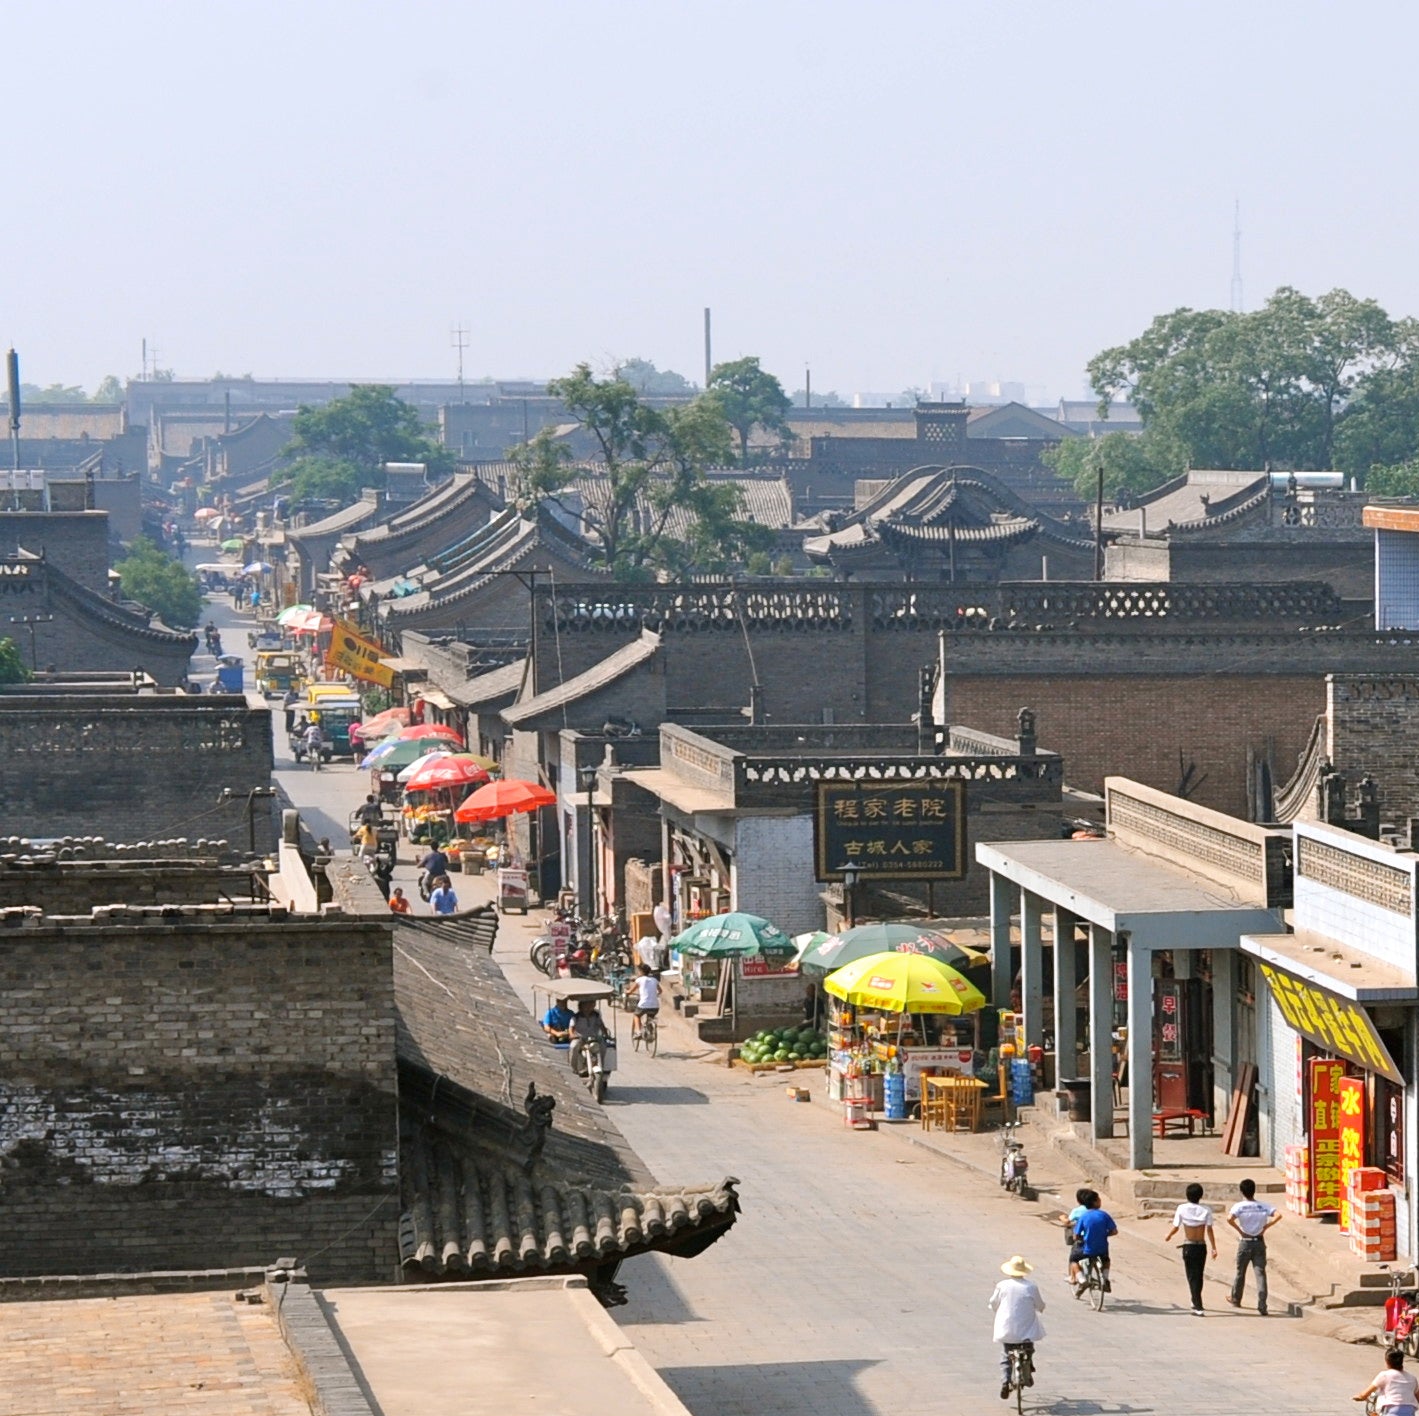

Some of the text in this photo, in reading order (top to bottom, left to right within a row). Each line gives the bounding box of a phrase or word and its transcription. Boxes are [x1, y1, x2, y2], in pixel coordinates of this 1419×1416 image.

[834, 799, 946, 818] 程家老院
[843, 840, 933, 855] 古城人家
